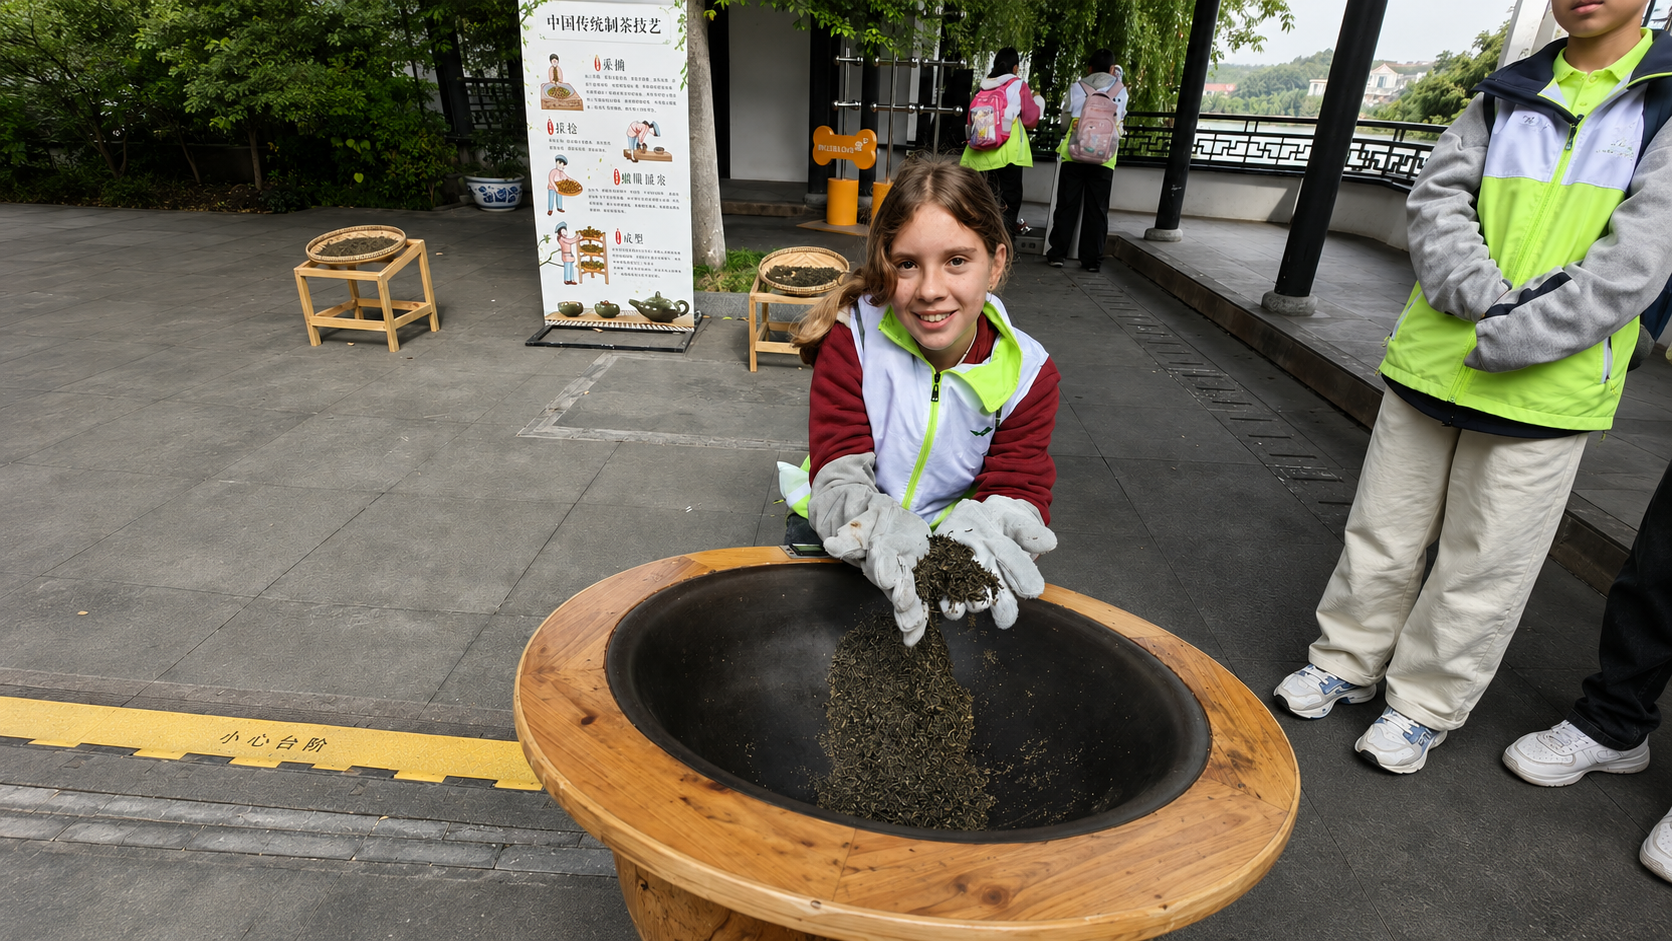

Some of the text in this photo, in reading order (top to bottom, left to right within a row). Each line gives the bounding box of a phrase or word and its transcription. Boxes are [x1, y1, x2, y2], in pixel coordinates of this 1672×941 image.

[547, 14, 662, 35] 中国传统制茶技艺
[219, 731, 328, 752] 小心台阶
